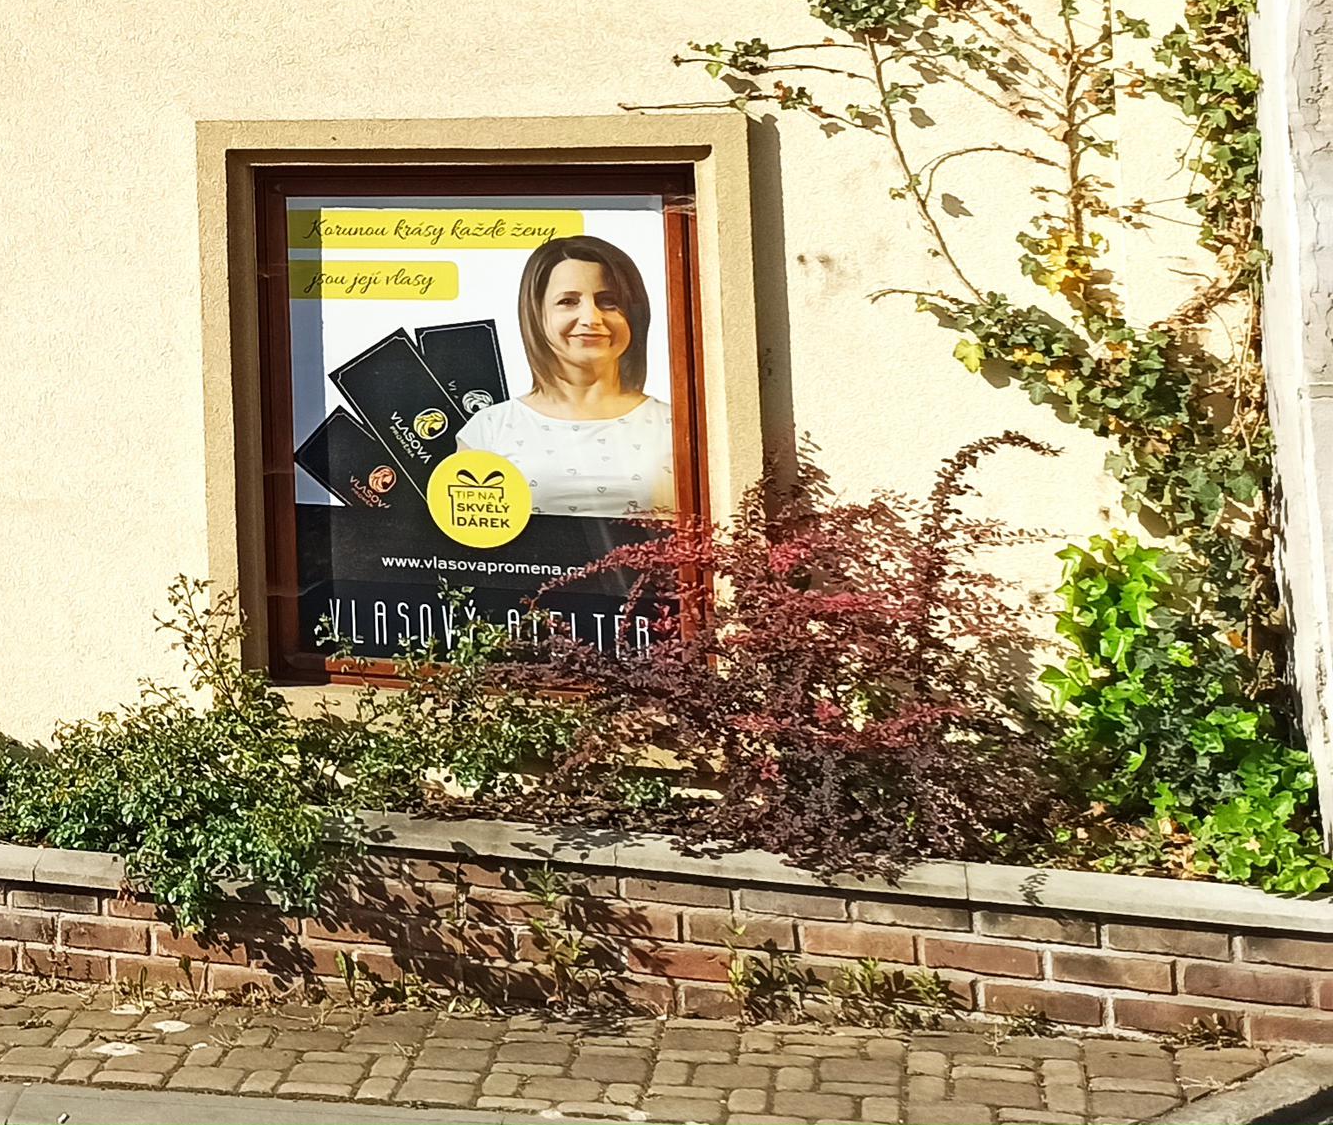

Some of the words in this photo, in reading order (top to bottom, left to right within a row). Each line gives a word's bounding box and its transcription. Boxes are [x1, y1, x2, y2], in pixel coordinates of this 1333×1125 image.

[303, 219, 388, 240] Korunou
[393, 219, 445, 246] krásy
[450, 219, 507, 239] každé
[509, 222, 558, 247] ženy
[304, 272, 348, 294] jsou
[345, 270, 382, 294] její
[385, 268, 437, 295] vlasy
[390, 411, 433, 465] VLASOVÁ
[454, 490, 475, 500] TIP
[478, 492, 496, 501] NA
[456, 502, 510, 513] SKVĚLÝ
[456, 516, 511, 529] DÁREK
[381, 555, 586, 578] www.vlasovapromena.cz
